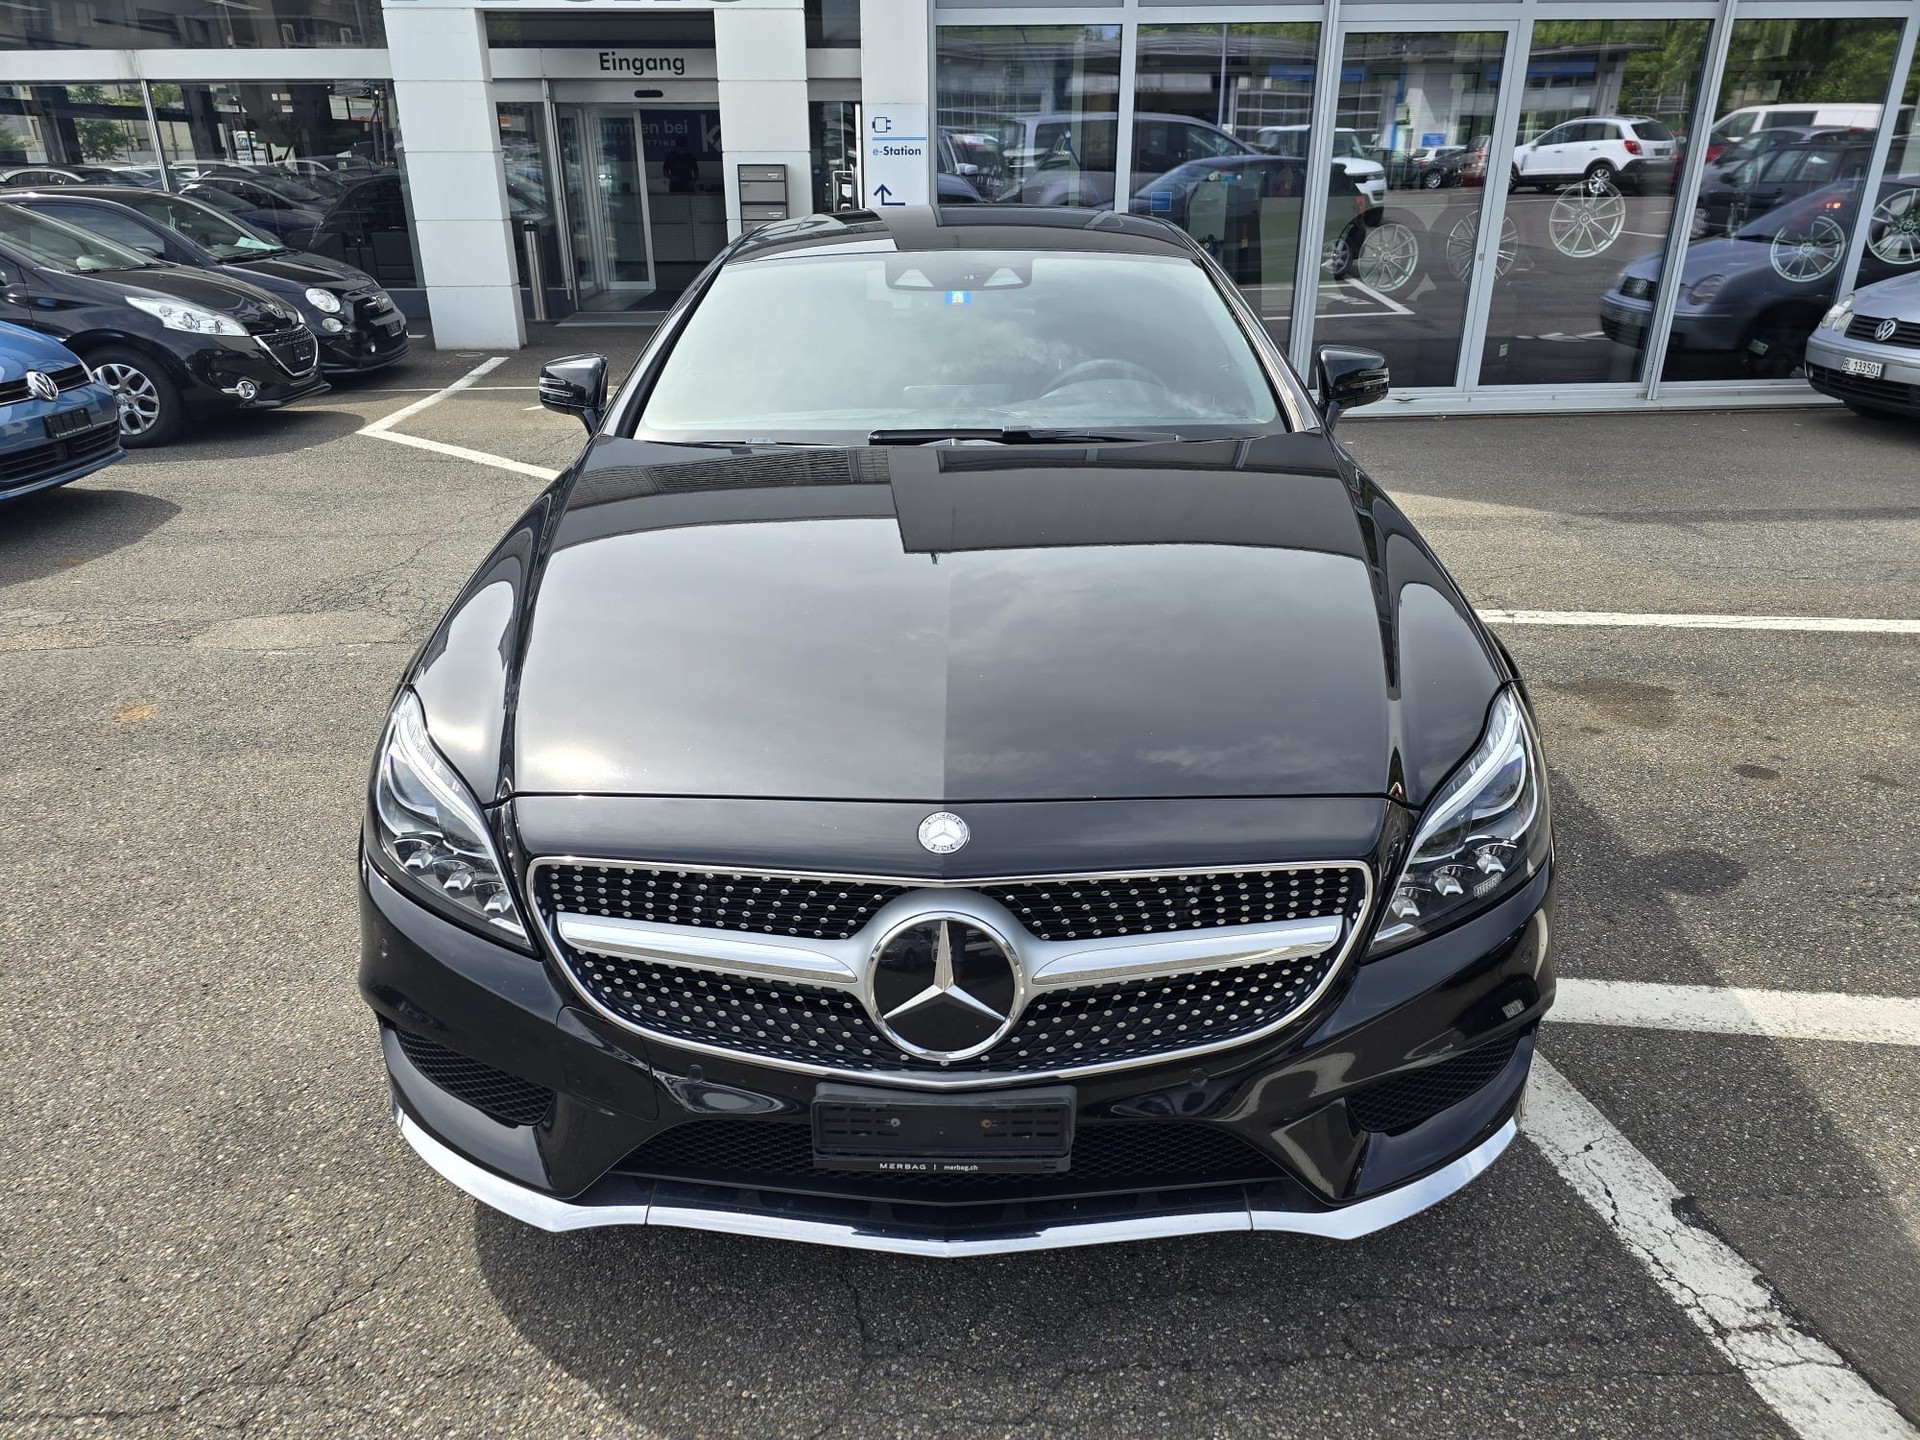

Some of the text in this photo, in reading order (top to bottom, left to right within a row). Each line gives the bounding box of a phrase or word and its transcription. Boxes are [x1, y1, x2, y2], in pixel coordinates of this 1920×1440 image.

[599, 51, 685, 75] Eingang
[664, 119, 688, 134] bei
[872, 145, 922, 156] e-Station
[1853, 360, 1880, 376] 133501
[879, 1162, 978, 1172] MERBAG merbag.ch
